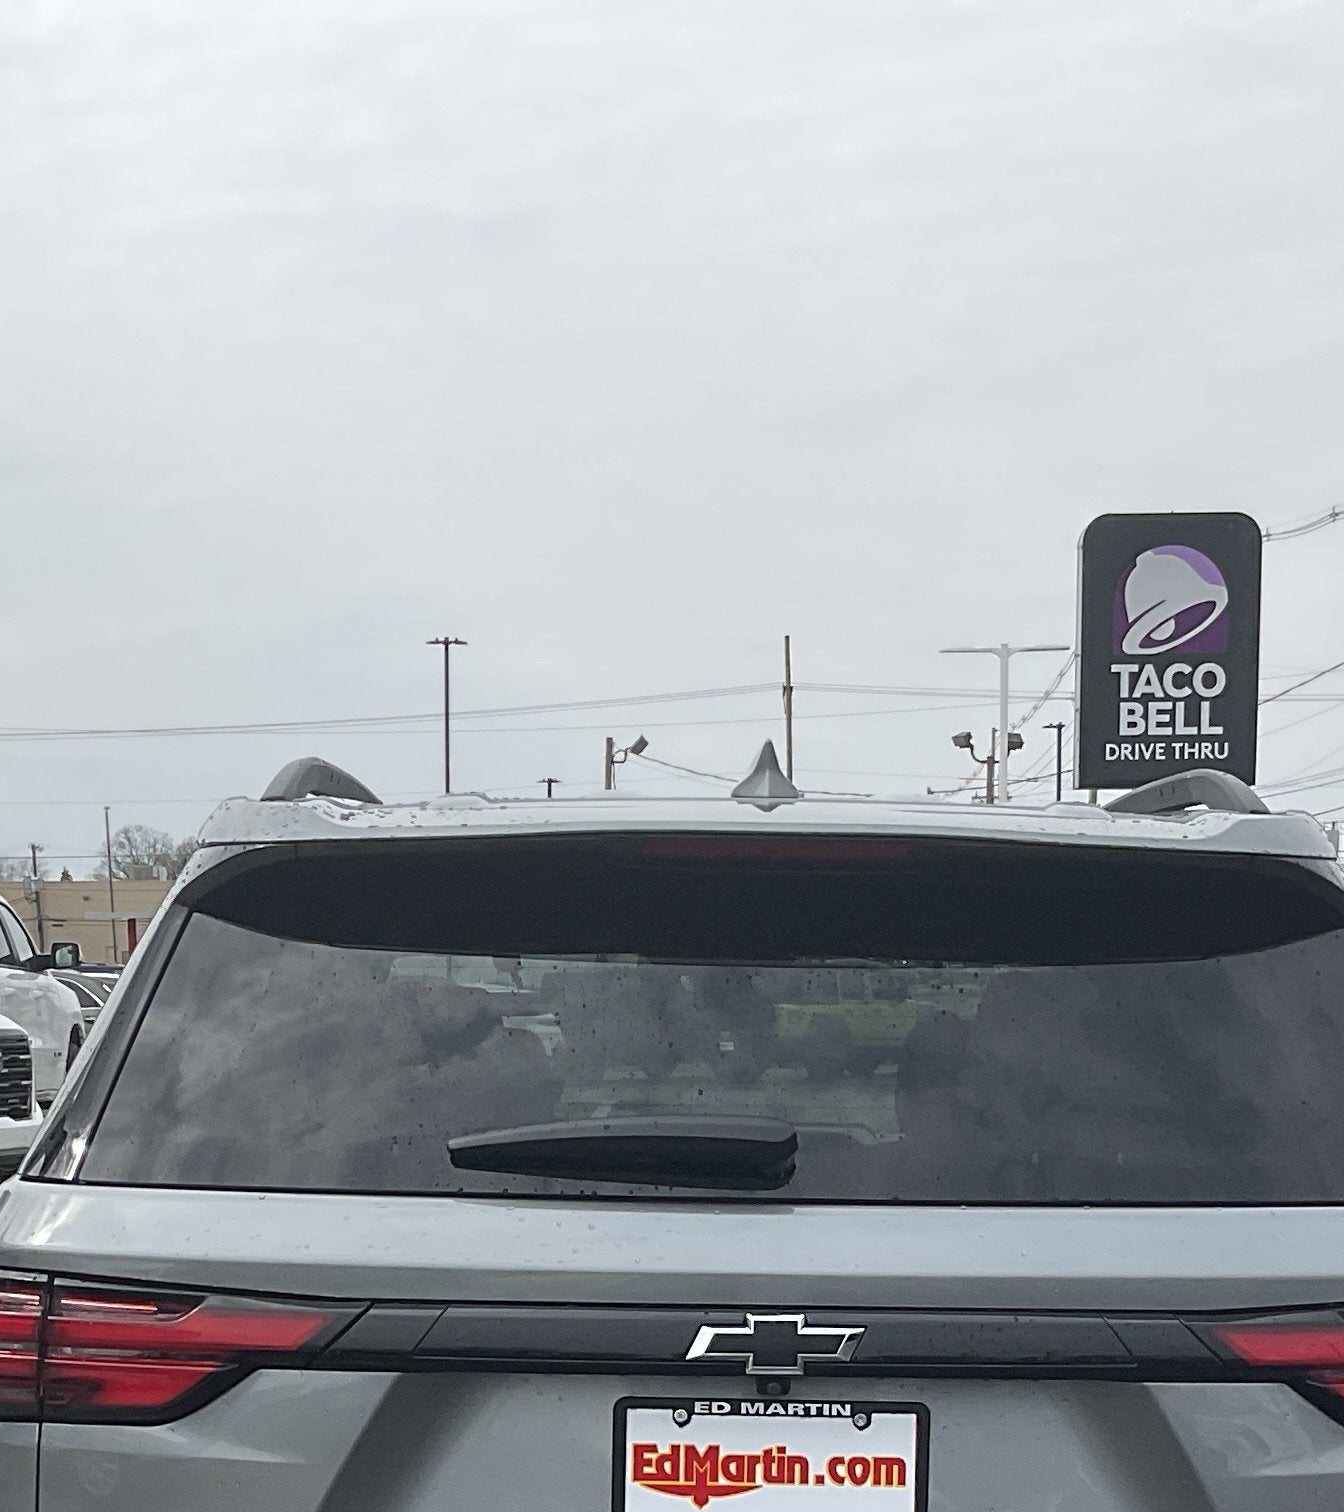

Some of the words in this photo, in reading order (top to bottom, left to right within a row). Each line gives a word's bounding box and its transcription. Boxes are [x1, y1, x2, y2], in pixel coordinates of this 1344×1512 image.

[1110, 662, 1227, 699] TACO
[1118, 701, 1224, 736] BELL
[1105, 744, 1166, 761] DRIVE
[1171, 742, 1229, 760] THRU
[694, 1401, 733, 1416] ED
[740, 1402, 852, 1417] MARTIN
[632, 1442, 907, 1488] EdMartin.com
